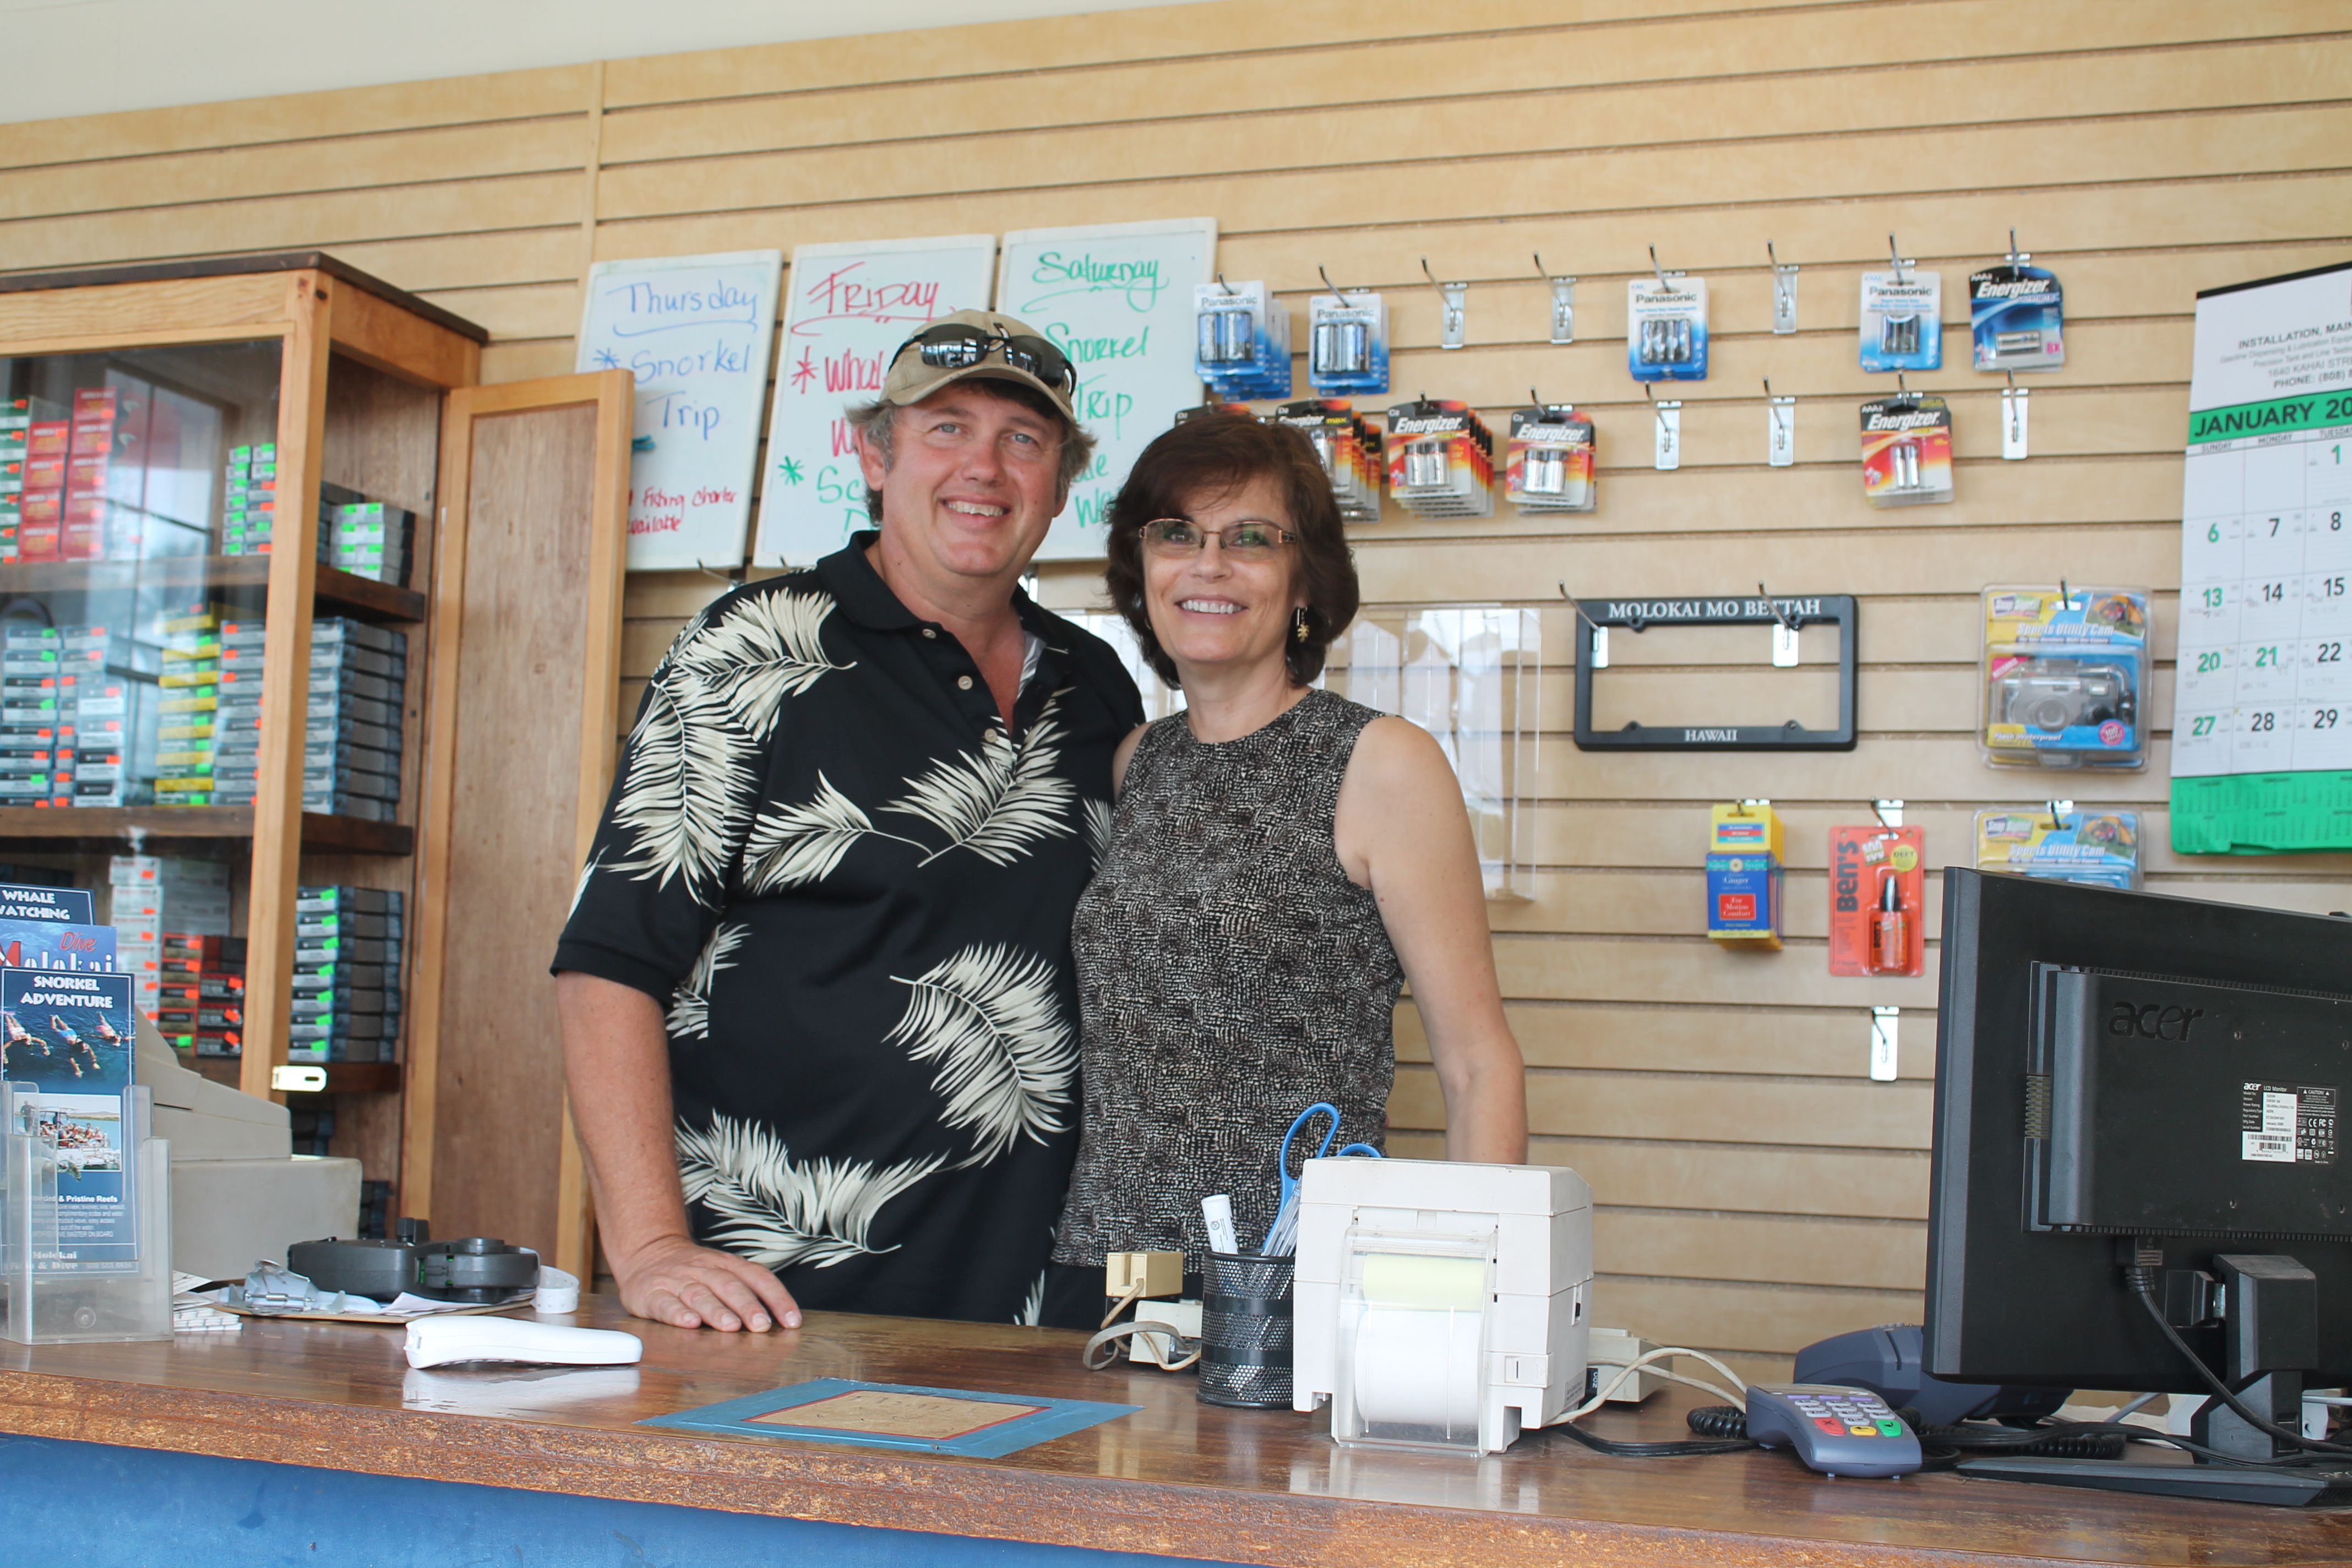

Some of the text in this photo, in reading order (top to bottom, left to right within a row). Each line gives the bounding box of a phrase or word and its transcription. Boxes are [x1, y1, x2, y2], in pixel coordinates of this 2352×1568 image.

[1636, 292, 1697, 303] Panasonic
[1870, 286, 1932, 296] Panasonic
[1977, 278, 2050, 298] Energizer
[606, 279, 758, 320] Thursday
[1202, 295, 1257, 306] Panasonic
[1317, 307, 1374, 318] Panasonic
[631, 339, 750, 384] Snorkel
[645, 390, 720, 440] Trip
[1868, 411, 1941, 431] Energizer
[2194, 401, 2315, 437] JANUARY
[1394, 416, 1463, 434] Energizer
[1516, 423, 1586, 443] Energizer
[2202, 442, 2233, 453] SUNDAY
[2258, 433, 2293, 443] MONDAY
[2331, 444, 2340, 465] 1
[2208, 511, 2342, 543] 6 7 8
[2202, 578, 2345, 608] 13 14 15
[1609, 601, 1701, 619] MOLOKAI
[1707, 600, 1739, 617] MO
[2017, 622, 2115, 636] Sports Utility Cam
[2197, 643, 2342, 672] 20 21 22
[2192, 709, 2339, 736] 27 28 29
[1684, 729, 1738, 742] HAWAII
[2016, 733, 2063, 742] Waterproof
[2008, 843, 2106, 858] Sports Utility Cam
[2, 889, 56, 904] WHALE
[59, 931, 97, 952] Dive
[34, 976, 100, 991] SNORKEL
[20, 992, 113, 1009] ADVENTURE
[2108, 1001, 2204, 1042] acer
[2243, 1082, 2262, 1091] acer
[96, 1195, 118, 1203] Reefs
